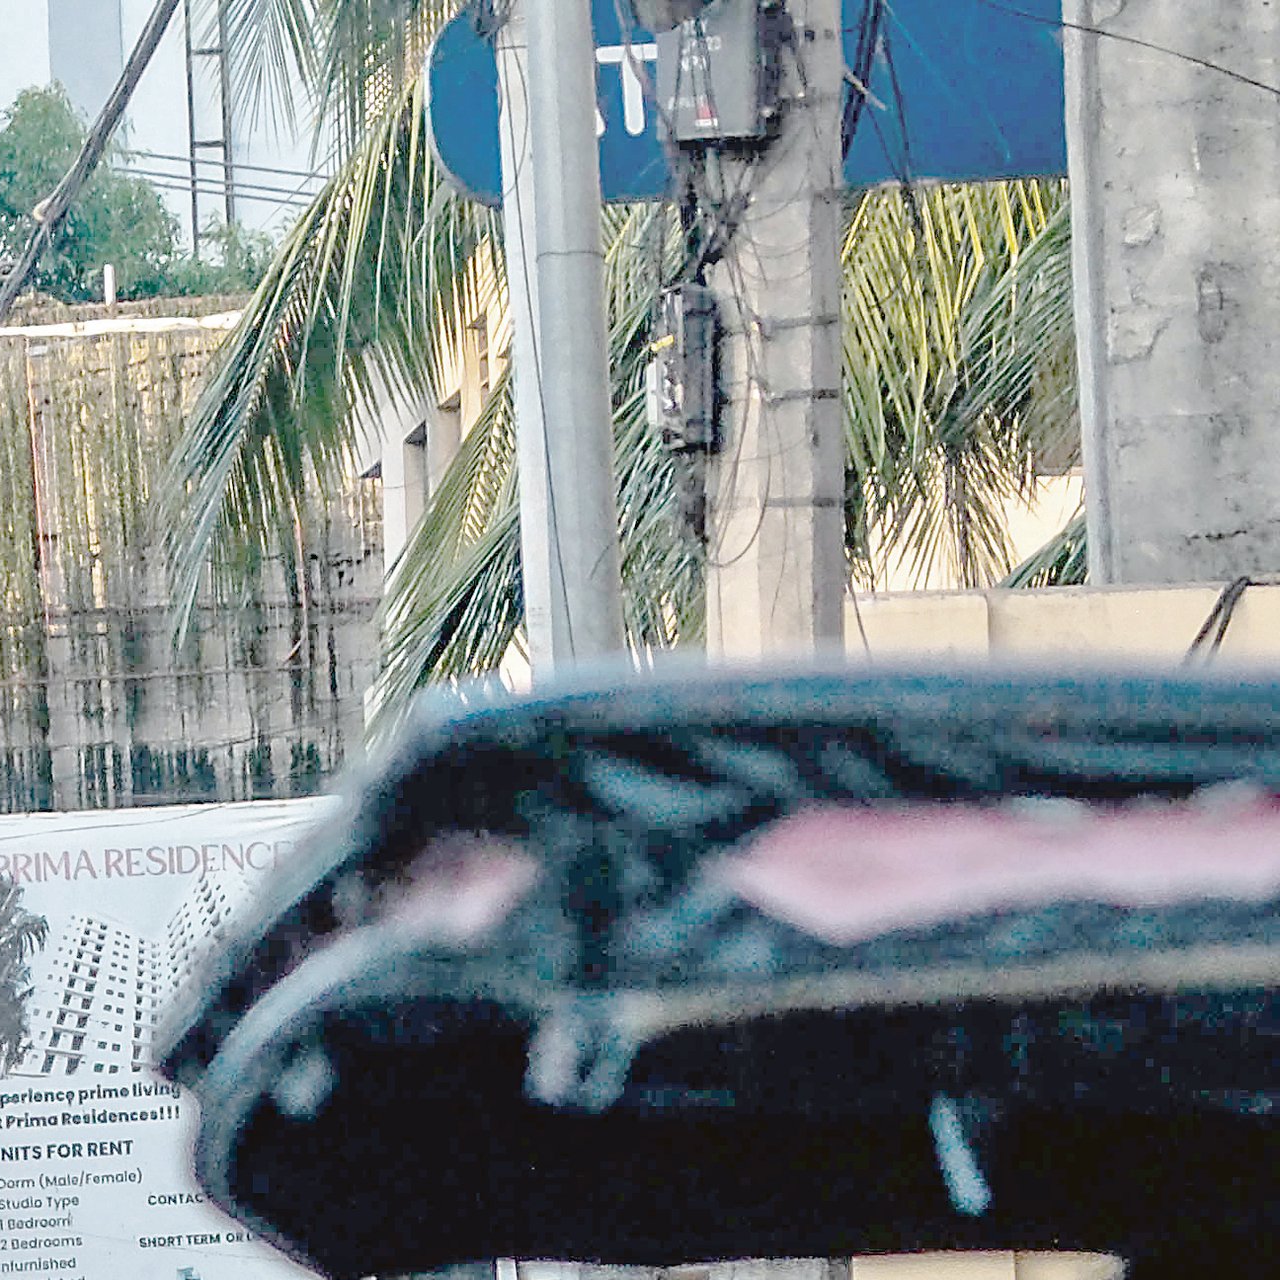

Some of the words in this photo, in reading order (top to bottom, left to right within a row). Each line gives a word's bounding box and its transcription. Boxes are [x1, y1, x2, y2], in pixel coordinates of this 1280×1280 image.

[77, 1084, 129, 1106] prime
[132, 1081, 181, 1100] living
[6, 1112, 58, 1129] Prima
[62, 1105, 180, 1126] Residences!!!
[46, 1143, 83, 1160] FOR
[87, 1140, 134, 1158] RENT
[39, 1167, 143, 1190] (Male/Female)
[46, 1195, 80, 1212] Type
[147, 1193, 212, 1206] CONTAC
[0, 1238, 8, 1251] 2
[11, 1236, 83, 1250] Bedrooms
[139, 1235, 183, 1248] SHORT
[186, 1233, 220, 1246] TERM
